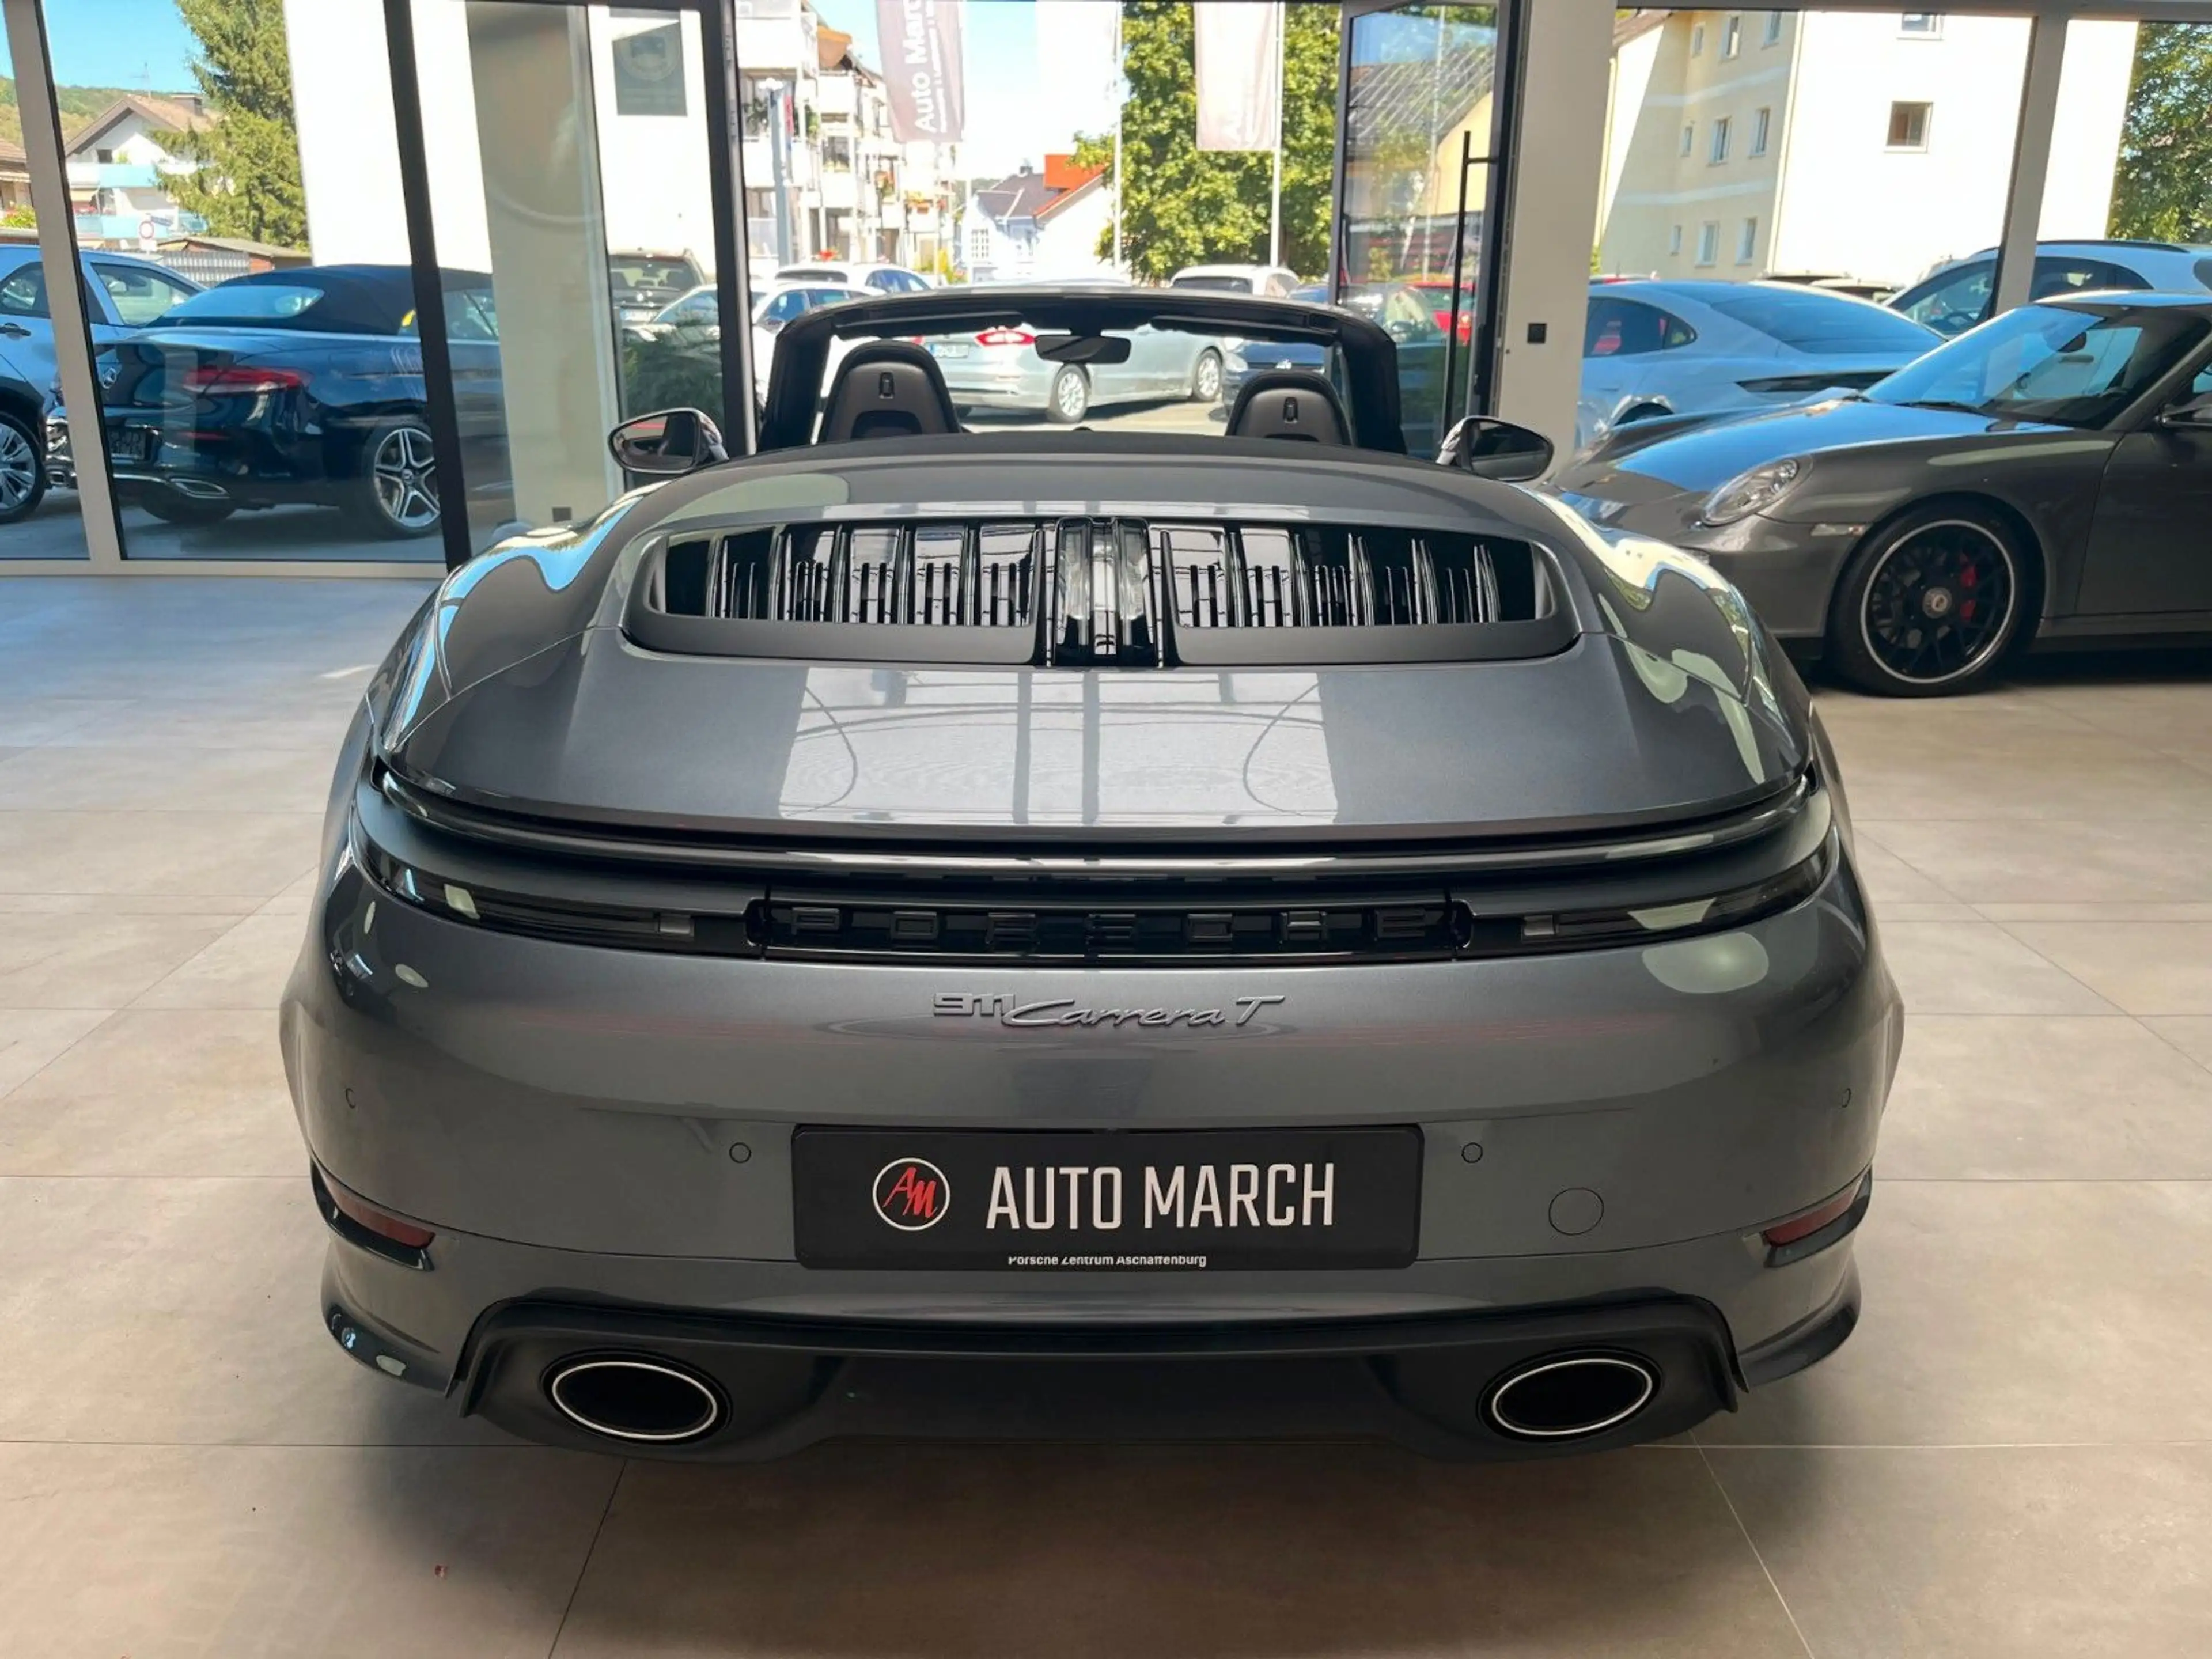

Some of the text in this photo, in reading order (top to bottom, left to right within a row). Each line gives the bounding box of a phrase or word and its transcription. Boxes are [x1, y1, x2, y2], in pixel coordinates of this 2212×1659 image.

[910, 71, 938, 134] Auto
[791, 907, 1427, 948] PORSCHE
[934, 992, 1285, 1027] 911 Carrera T
[986, 1162, 1335, 1230] AUTO MARCH
[1008, 1255, 1059, 1266] Porsche
